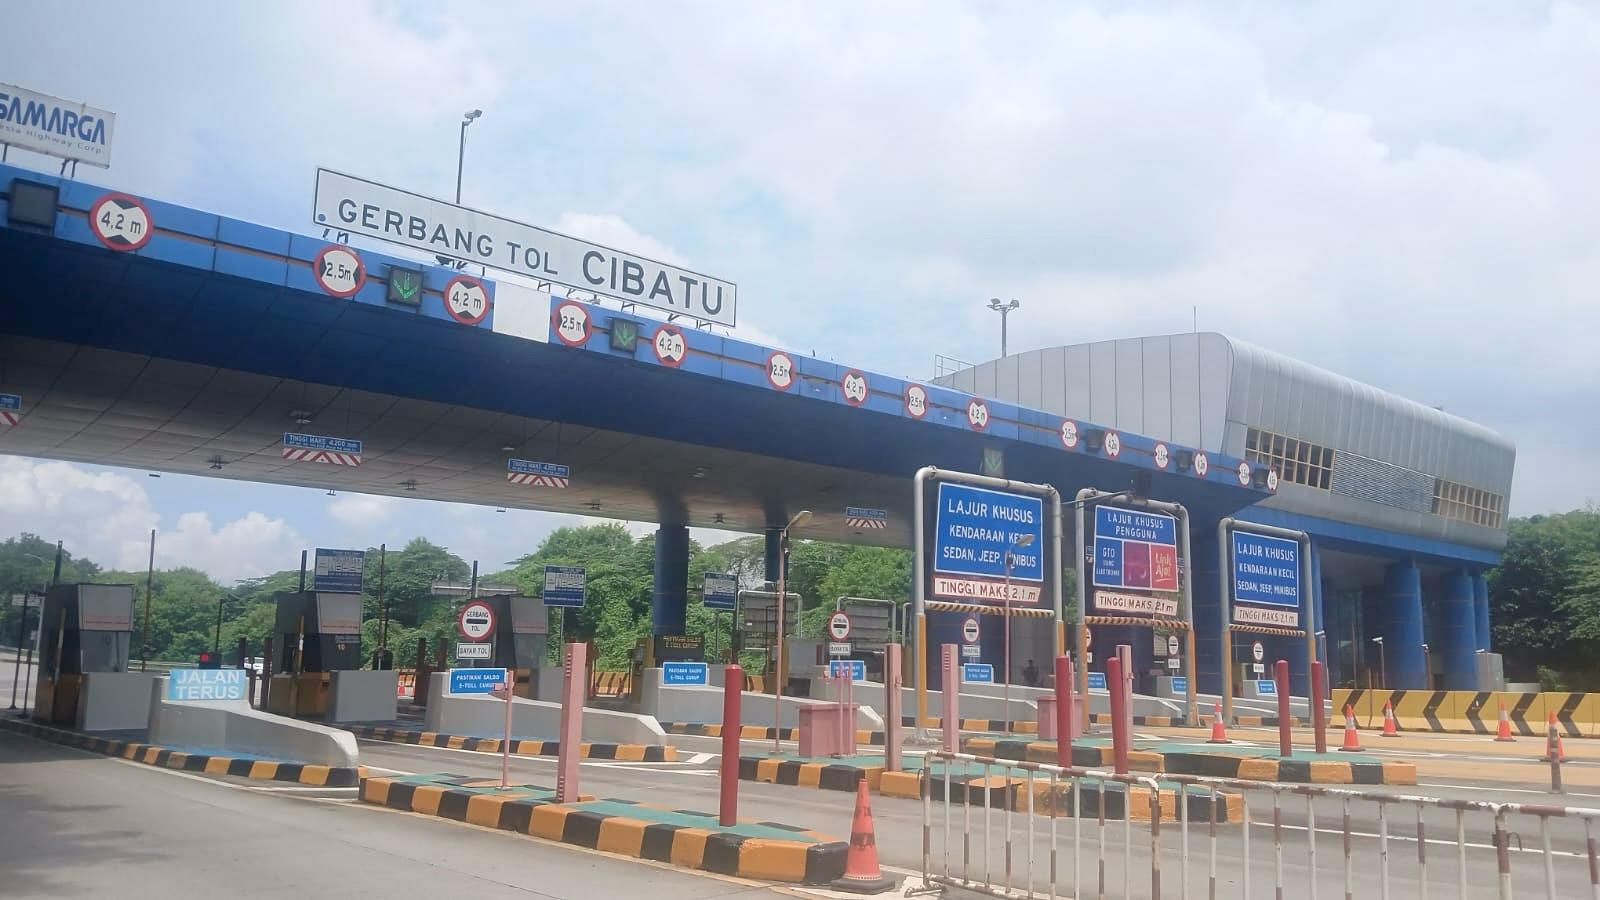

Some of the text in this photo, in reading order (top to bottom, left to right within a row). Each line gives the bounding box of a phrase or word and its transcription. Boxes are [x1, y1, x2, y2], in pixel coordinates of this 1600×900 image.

[26, 130, 73, 148] Highway
[101, 210, 141, 234] 4,2 m
[338, 198, 722, 316] GERBANG TOL CIBATU
[473, 297, 482, 310] m
[948, 498, 1033, 524] LAJUR KHUSUS
[1107, 512, 1164, 529] LAJUR KHUSUS
[949, 524, 1005, 543] KENDARAAN
[1115, 525, 1157, 540] PENGGUNA
[1238, 542, 1295, 562] LAJUR KHUSUS
[1239, 562, 1295, 580] KENDARAAN KECIL
[940, 581, 976, 597] TINGGI
[1099, 596, 1127, 607] TINGGI
[177, 670, 240, 684] JALAN
[176, 686, 240, 699] TERUS
